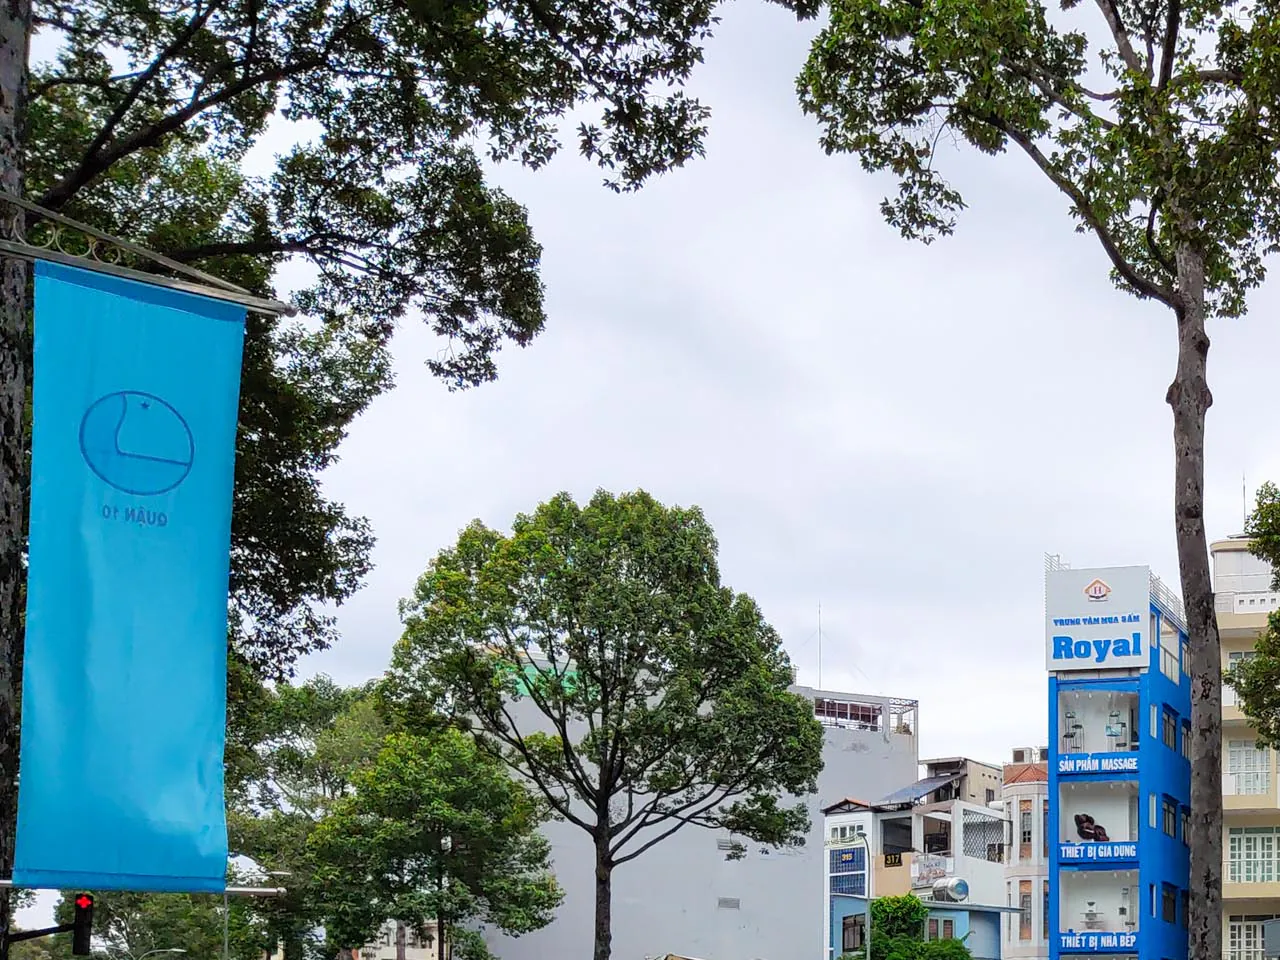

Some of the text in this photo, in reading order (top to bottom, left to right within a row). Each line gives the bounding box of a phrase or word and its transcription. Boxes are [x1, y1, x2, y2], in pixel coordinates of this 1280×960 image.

[1053, 612, 1140, 627] TRUNG TÂM MUA SẮM
[1052, 632, 1142, 663] Royal
[1058, 752, 1138, 772] SẢN PHẨM MASSAGE
[886, 854, 900, 864] 317
[1060, 842, 1137, 860] THIẾT BỊ GIA DỤNG
[1060, 931, 1137, 951] THIẾT BỊ NHÀ BẾP
